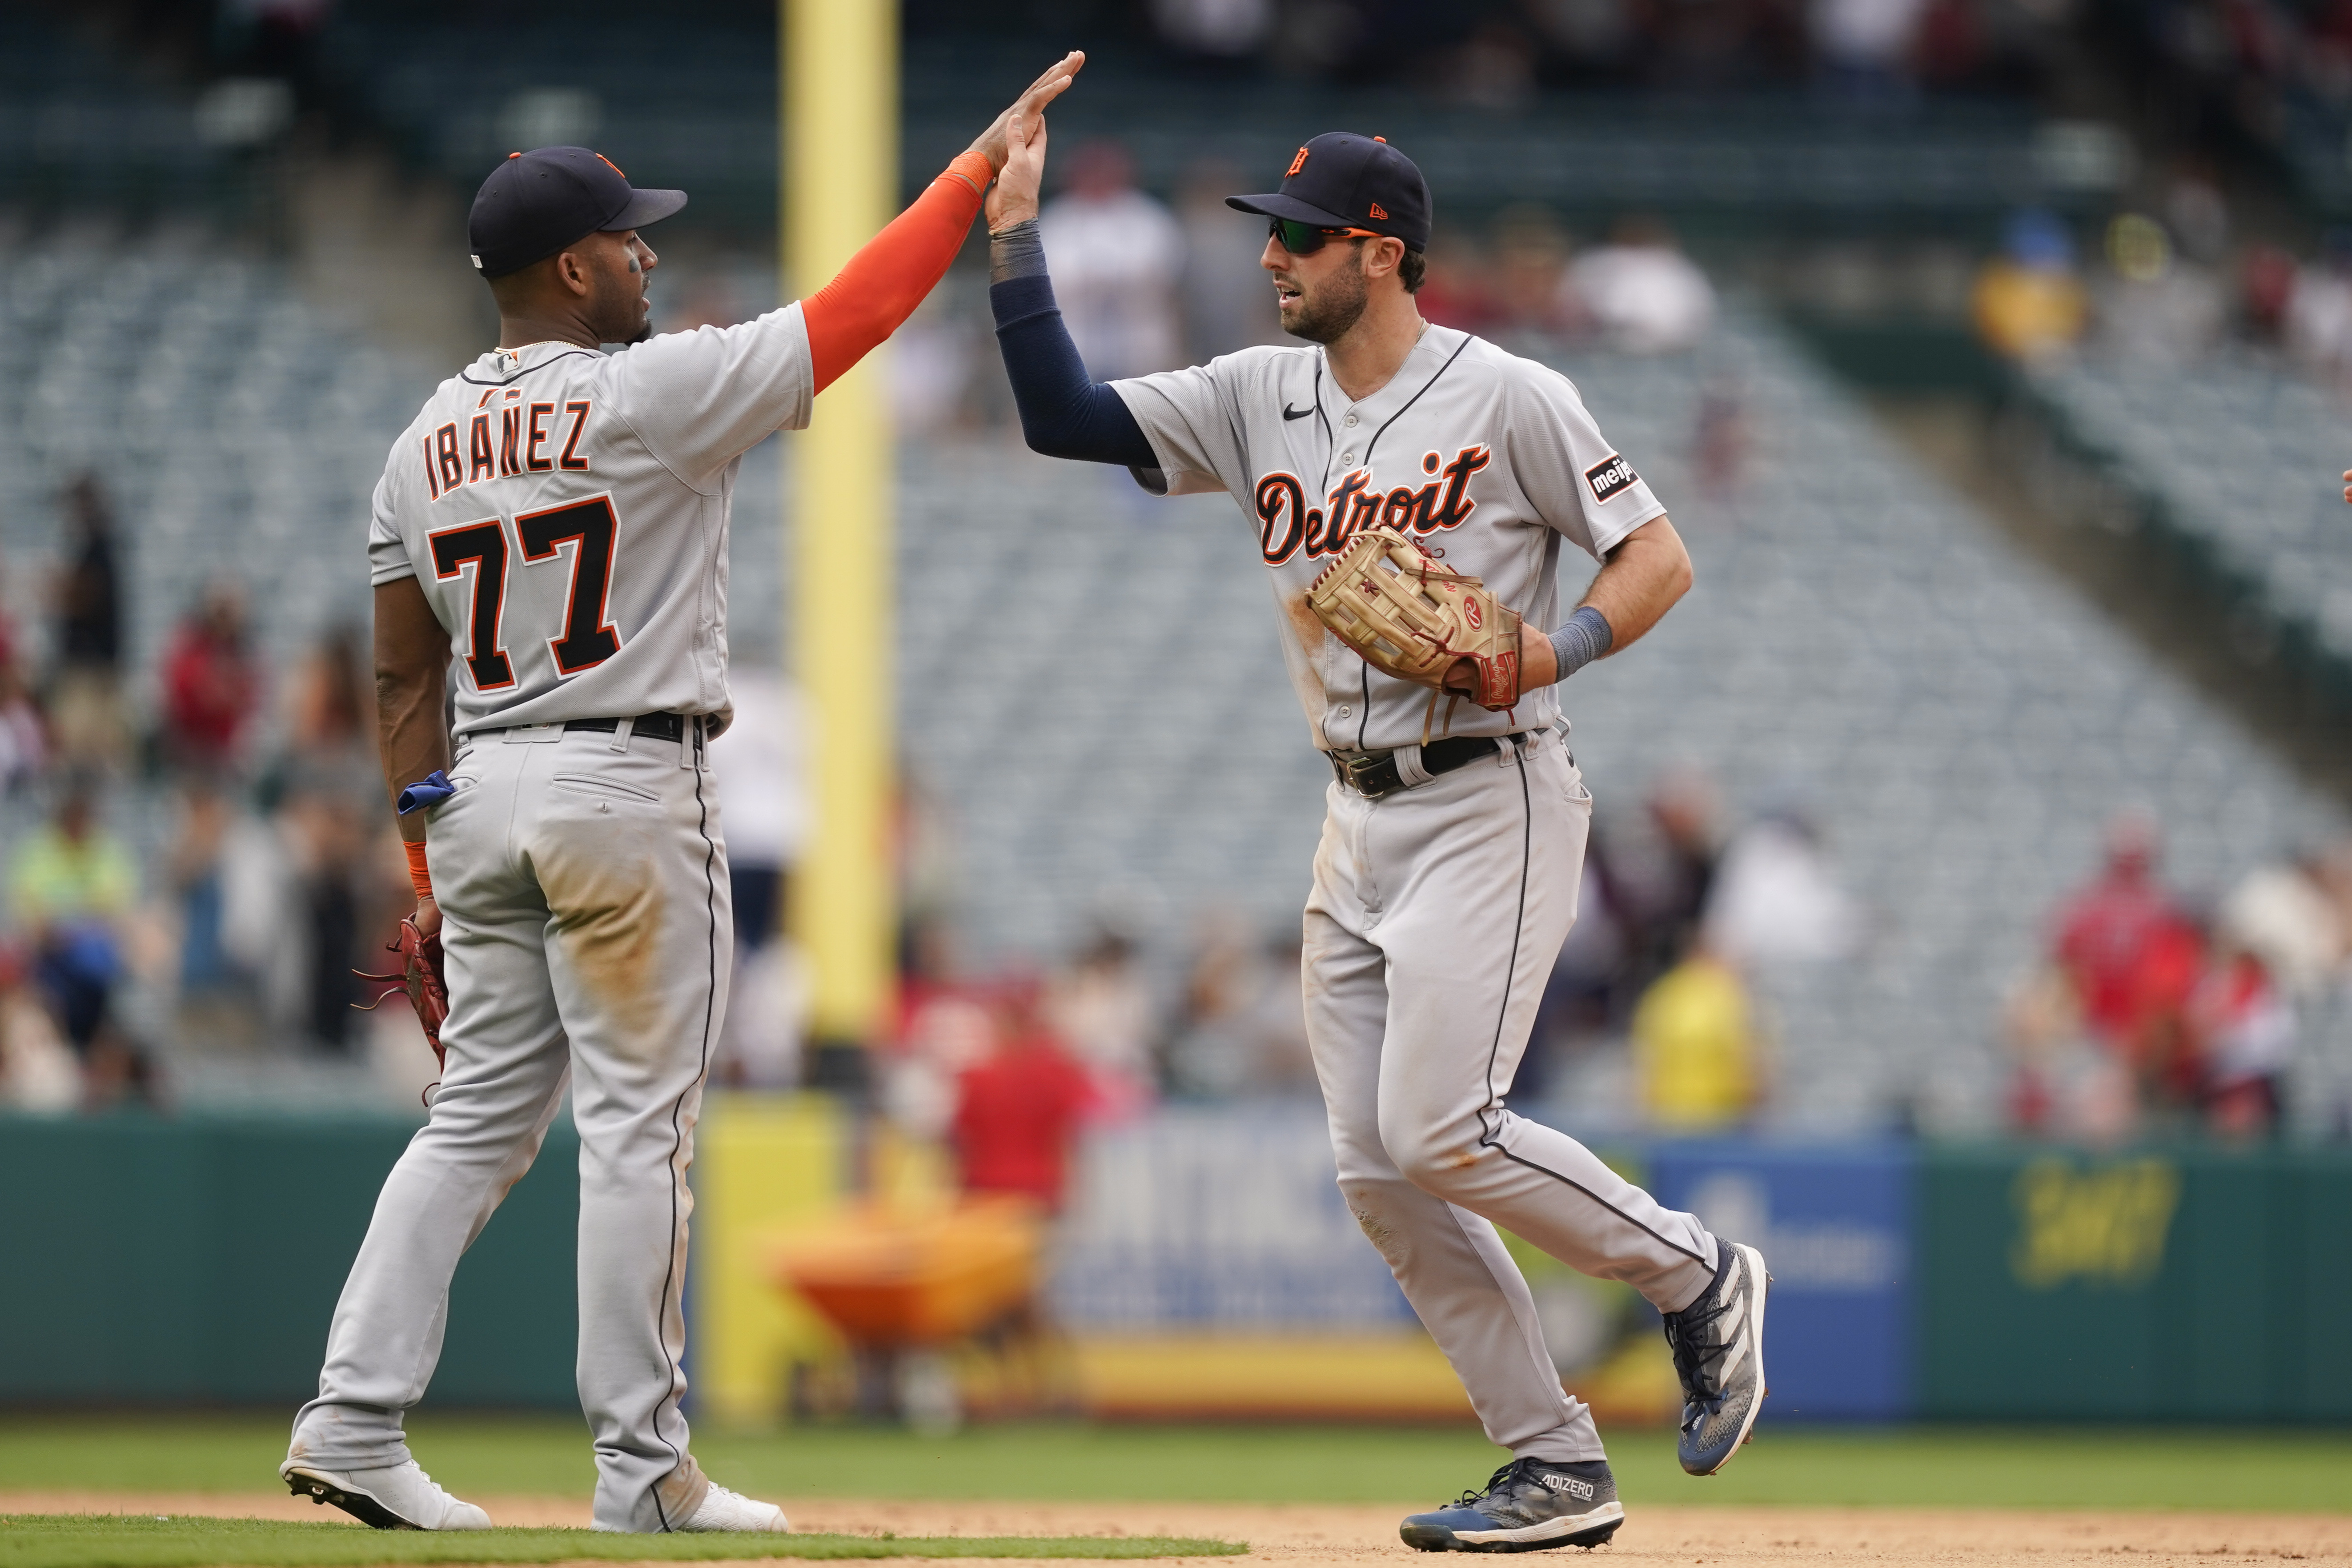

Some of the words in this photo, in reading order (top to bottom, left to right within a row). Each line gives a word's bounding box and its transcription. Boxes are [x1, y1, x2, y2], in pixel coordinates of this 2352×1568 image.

[422, 387, 592, 503] IBÁÑEZ
[1255, 442, 1491, 567] Detroit
[425, 490, 624, 695] 77
[1542, 1474, 1593, 1497] ADIZERO
